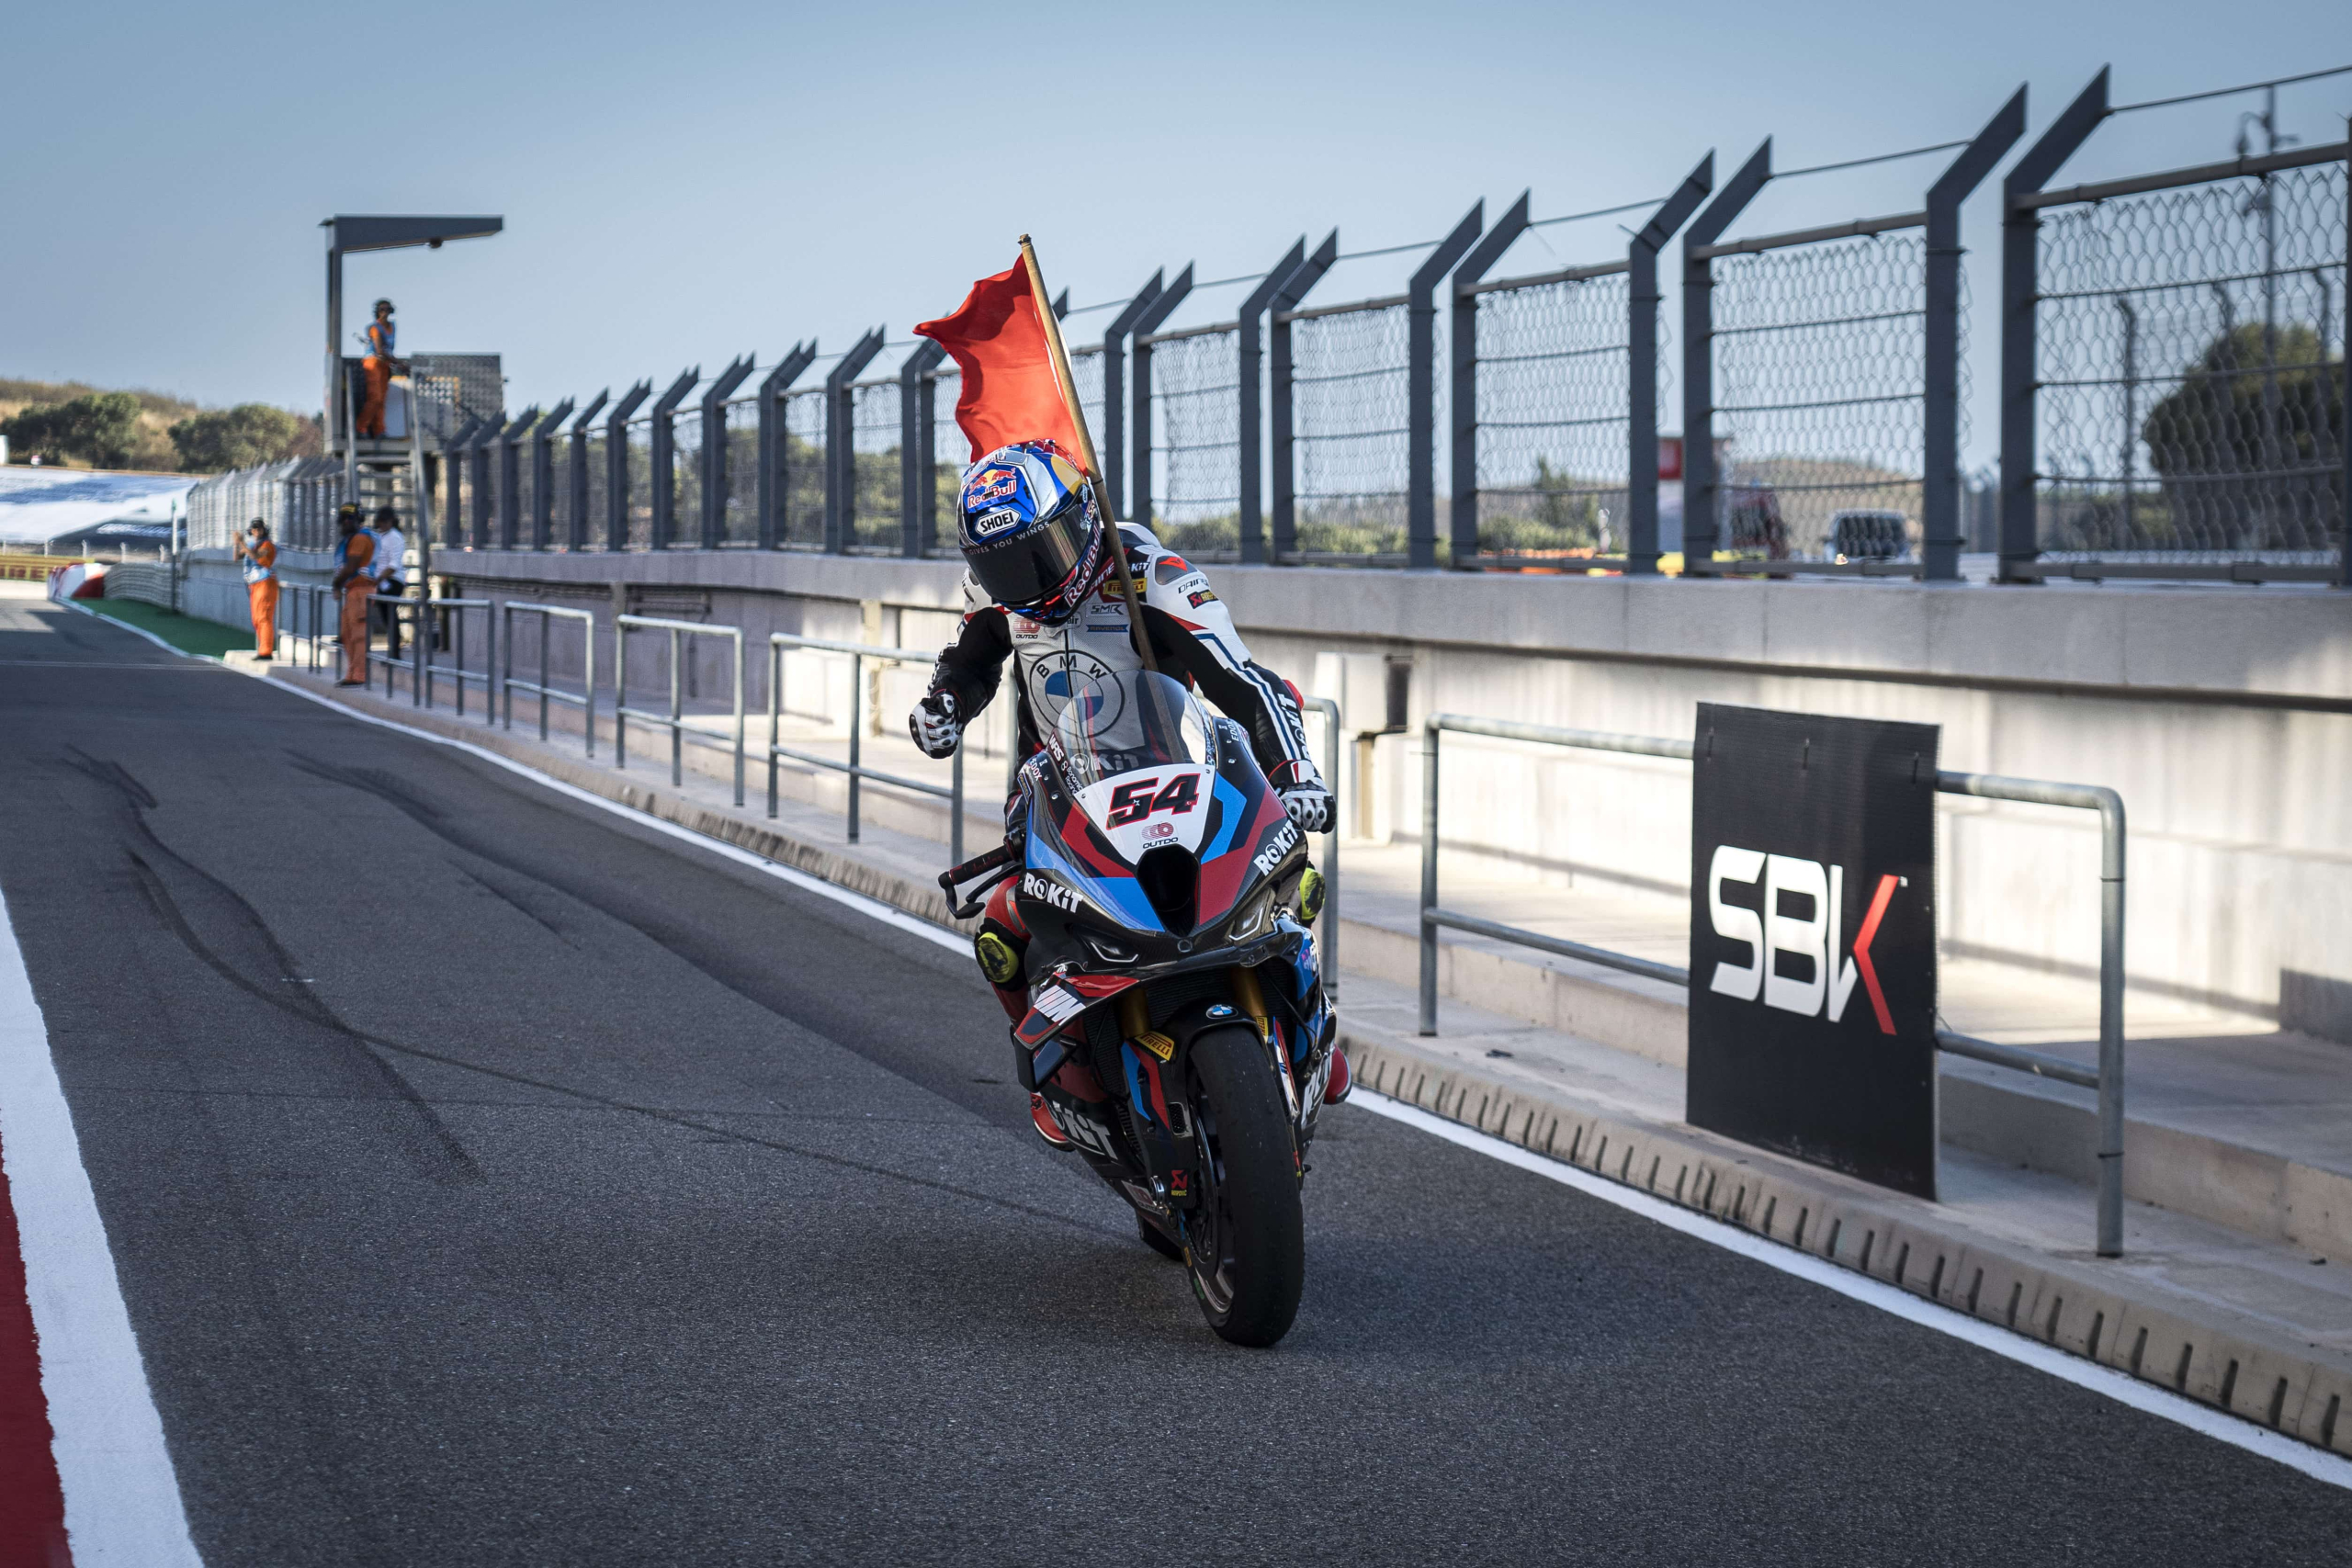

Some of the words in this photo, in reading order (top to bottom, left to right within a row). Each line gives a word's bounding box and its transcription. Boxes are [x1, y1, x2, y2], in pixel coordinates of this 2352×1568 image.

[967, 488, 990, 508] Red
[992, 479, 1017, 498] Bull
[979, 512, 1014, 533] SHOEI
[968, 545, 989, 556] GIVES
[992, 538, 1012, 549] YOU
[1016, 521, 1051, 541] WINGS
[1065, 563, 1093, 608] Red
[1091, 604, 1124, 615] SMR
[1048, 733, 1065, 761] WRS
[1029, 758, 1043, 782] EDOX
[1106, 773, 1201, 831] 54
[1143, 837, 1179, 850] OUTDO
[1253, 819, 1298, 876] ROKiT
[1023, 872, 1084, 914] ROKiT
[1708, 844, 1899, 1036] SBK
[1140, 1032, 1172, 1056] PIRELLI
